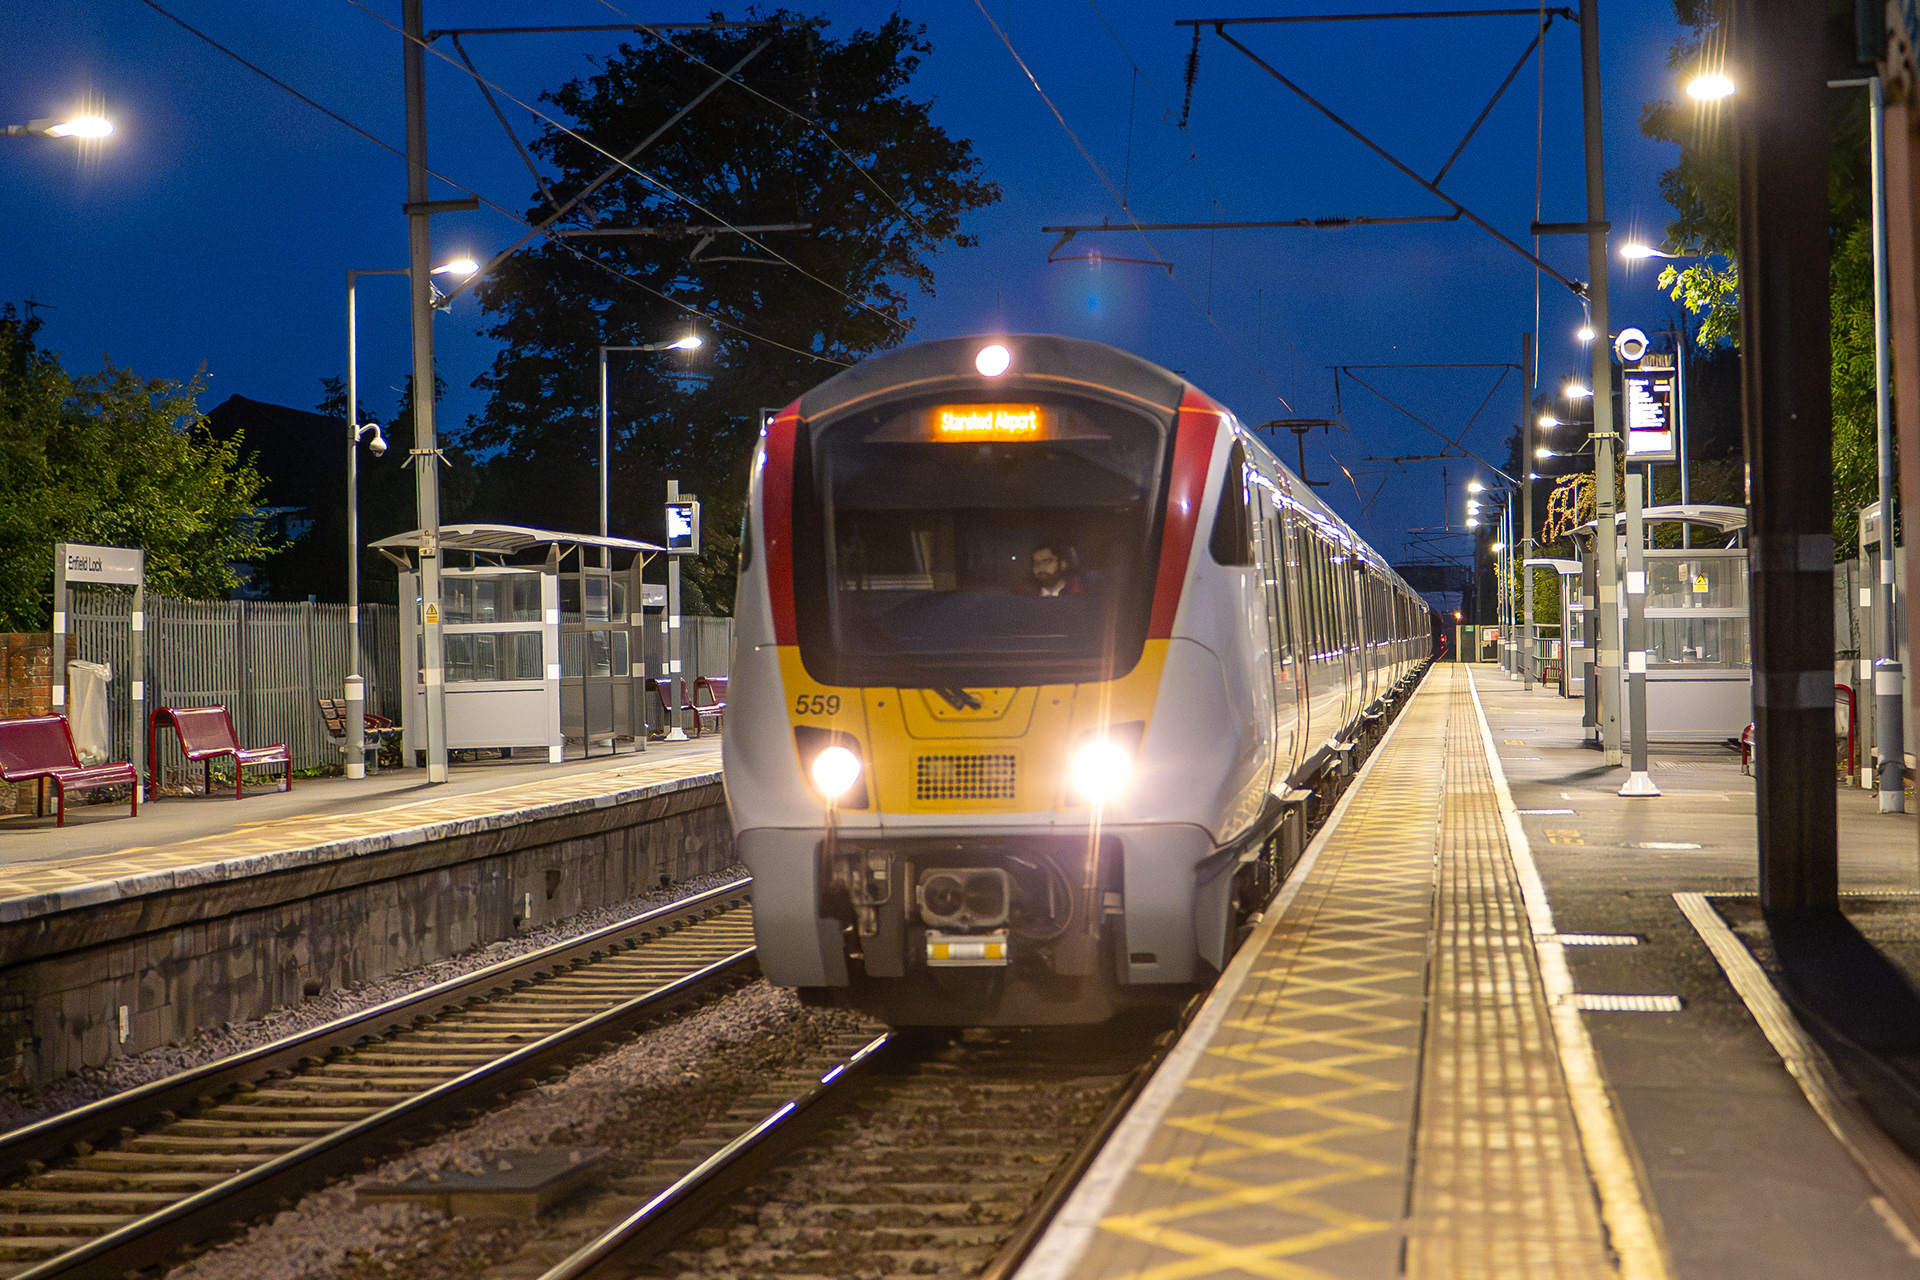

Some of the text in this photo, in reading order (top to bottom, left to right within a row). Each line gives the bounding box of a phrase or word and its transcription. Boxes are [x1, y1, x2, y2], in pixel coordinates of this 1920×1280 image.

[941, 410, 1037, 433] Stansted Airport
[68, 555, 103, 572] Enfield Lock
[795, 694, 840, 715] 559
